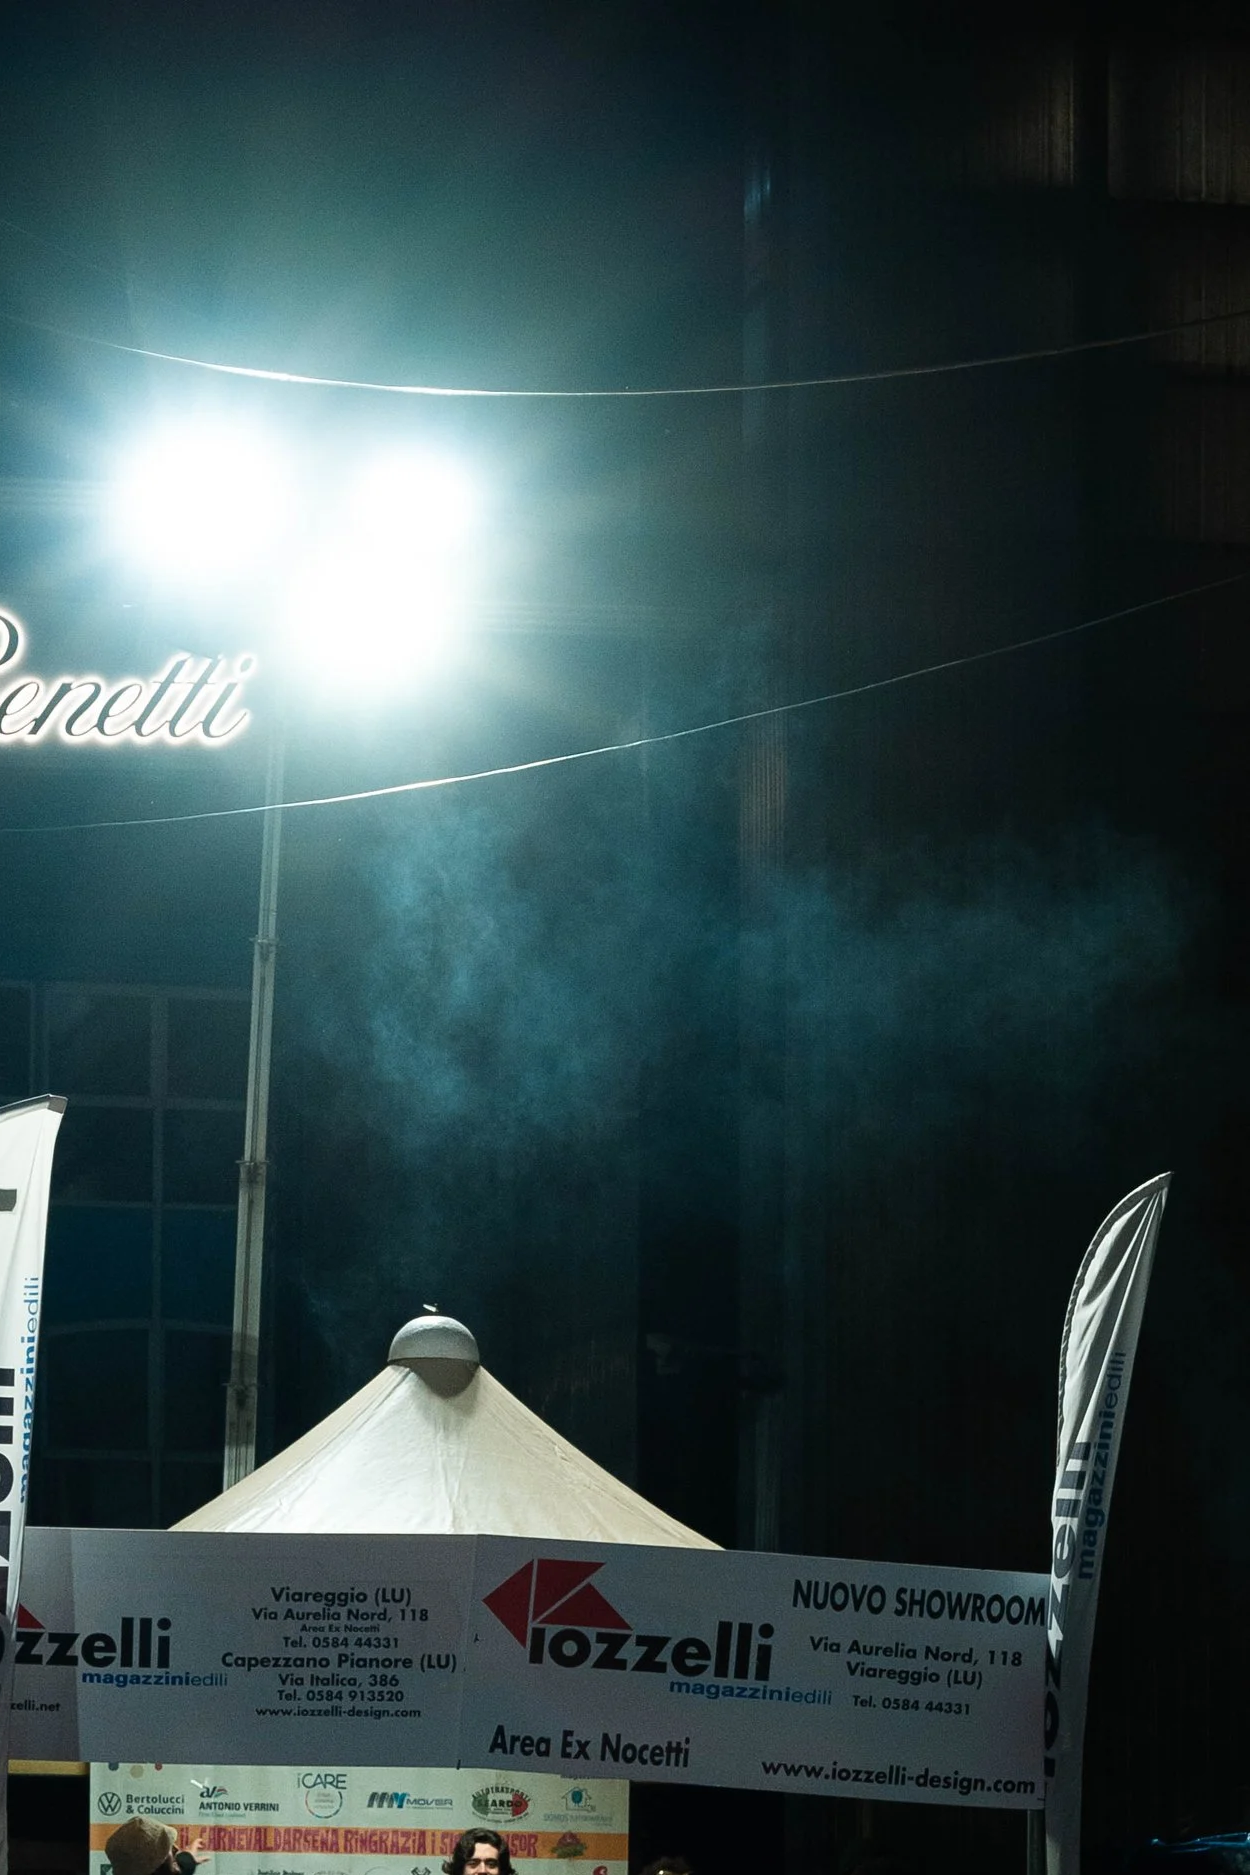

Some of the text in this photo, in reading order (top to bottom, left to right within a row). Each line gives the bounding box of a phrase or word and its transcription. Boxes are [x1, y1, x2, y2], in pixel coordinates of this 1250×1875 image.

[19, 1276, 39, 1503] magazziniedili
[1078, 1351, 1126, 1580] magazziniedili
[271, 1586, 412, 1607] Viareggio (LU)
[792, 1579, 1046, 1627] NUOVO SHOWROOM
[251, 1608, 429, 1623] Via Aurelia Nord, 118
[300, 1624, 380, 1633] Area Ex Nocetti
[14, 1616, 172, 1668] zzelli
[283, 1637, 399, 1648] Tel. 0584 44331
[809, 1635, 1023, 1666] Via Aurelia Nord, 118
[221, 1652, 458, 1673] Capezzano Pianore (LU)
[81, 1672, 228, 1688] magazziniedili
[278, 1673, 400, 1688] Via Italica, 386
[846, 1661, 983, 1690] Viareggio (LU)
[277, 1690, 404, 1701] Tel. 0584 913520
[669, 1680, 833, 1705] magazziniedili
[255, 1705, 421, 1720] www.iozzelli-design.com
[852, 1695, 971, 1716] Tel. 0584 44331
[488, 1724, 691, 1767] Area Ex Nocetti
[297, 1772, 347, 1790] iCARE
[761, 1761, 1036, 1796] www.iozzelli-design.com
[125, 1793, 185, 1804] Bertolucci
[199, 1802, 280, 1812] ANTONIO VERRINI
[125, 1805, 185, 1815] & Coluccini
